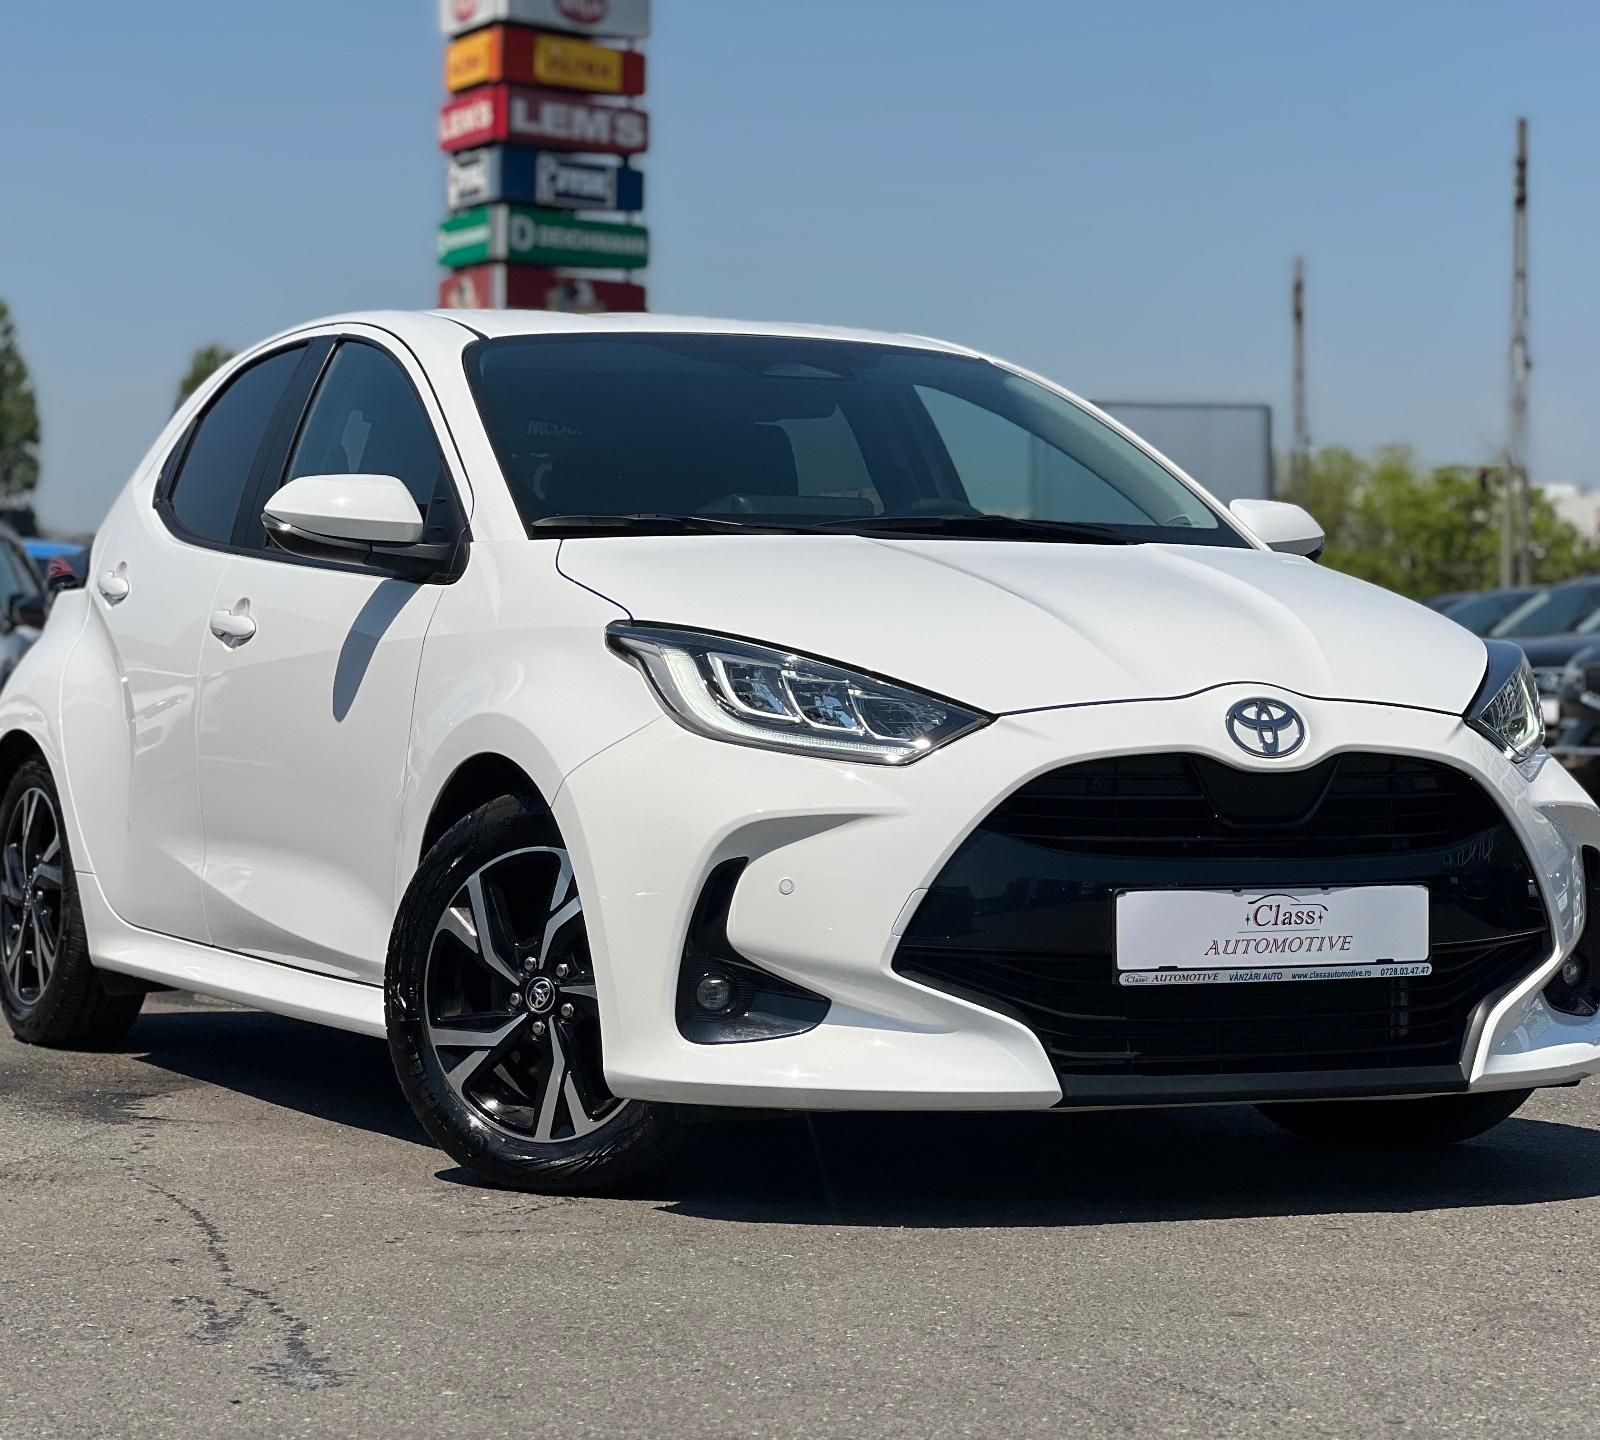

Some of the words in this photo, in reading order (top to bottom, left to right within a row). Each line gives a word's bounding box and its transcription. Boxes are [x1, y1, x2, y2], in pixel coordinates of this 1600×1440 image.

[1253, 904, 1316, 927] Class
[1204, 935, 1354, 956] AUTOMOTIVE
[1152, 972, 1219, 983] AUTOMOTIVE
[1261, 971, 1283, 981] AUTO
[1291, 969, 1372, 980] www.classautomotive.ro
[1380, 966, 1430, 977] 0728.03.47.47
